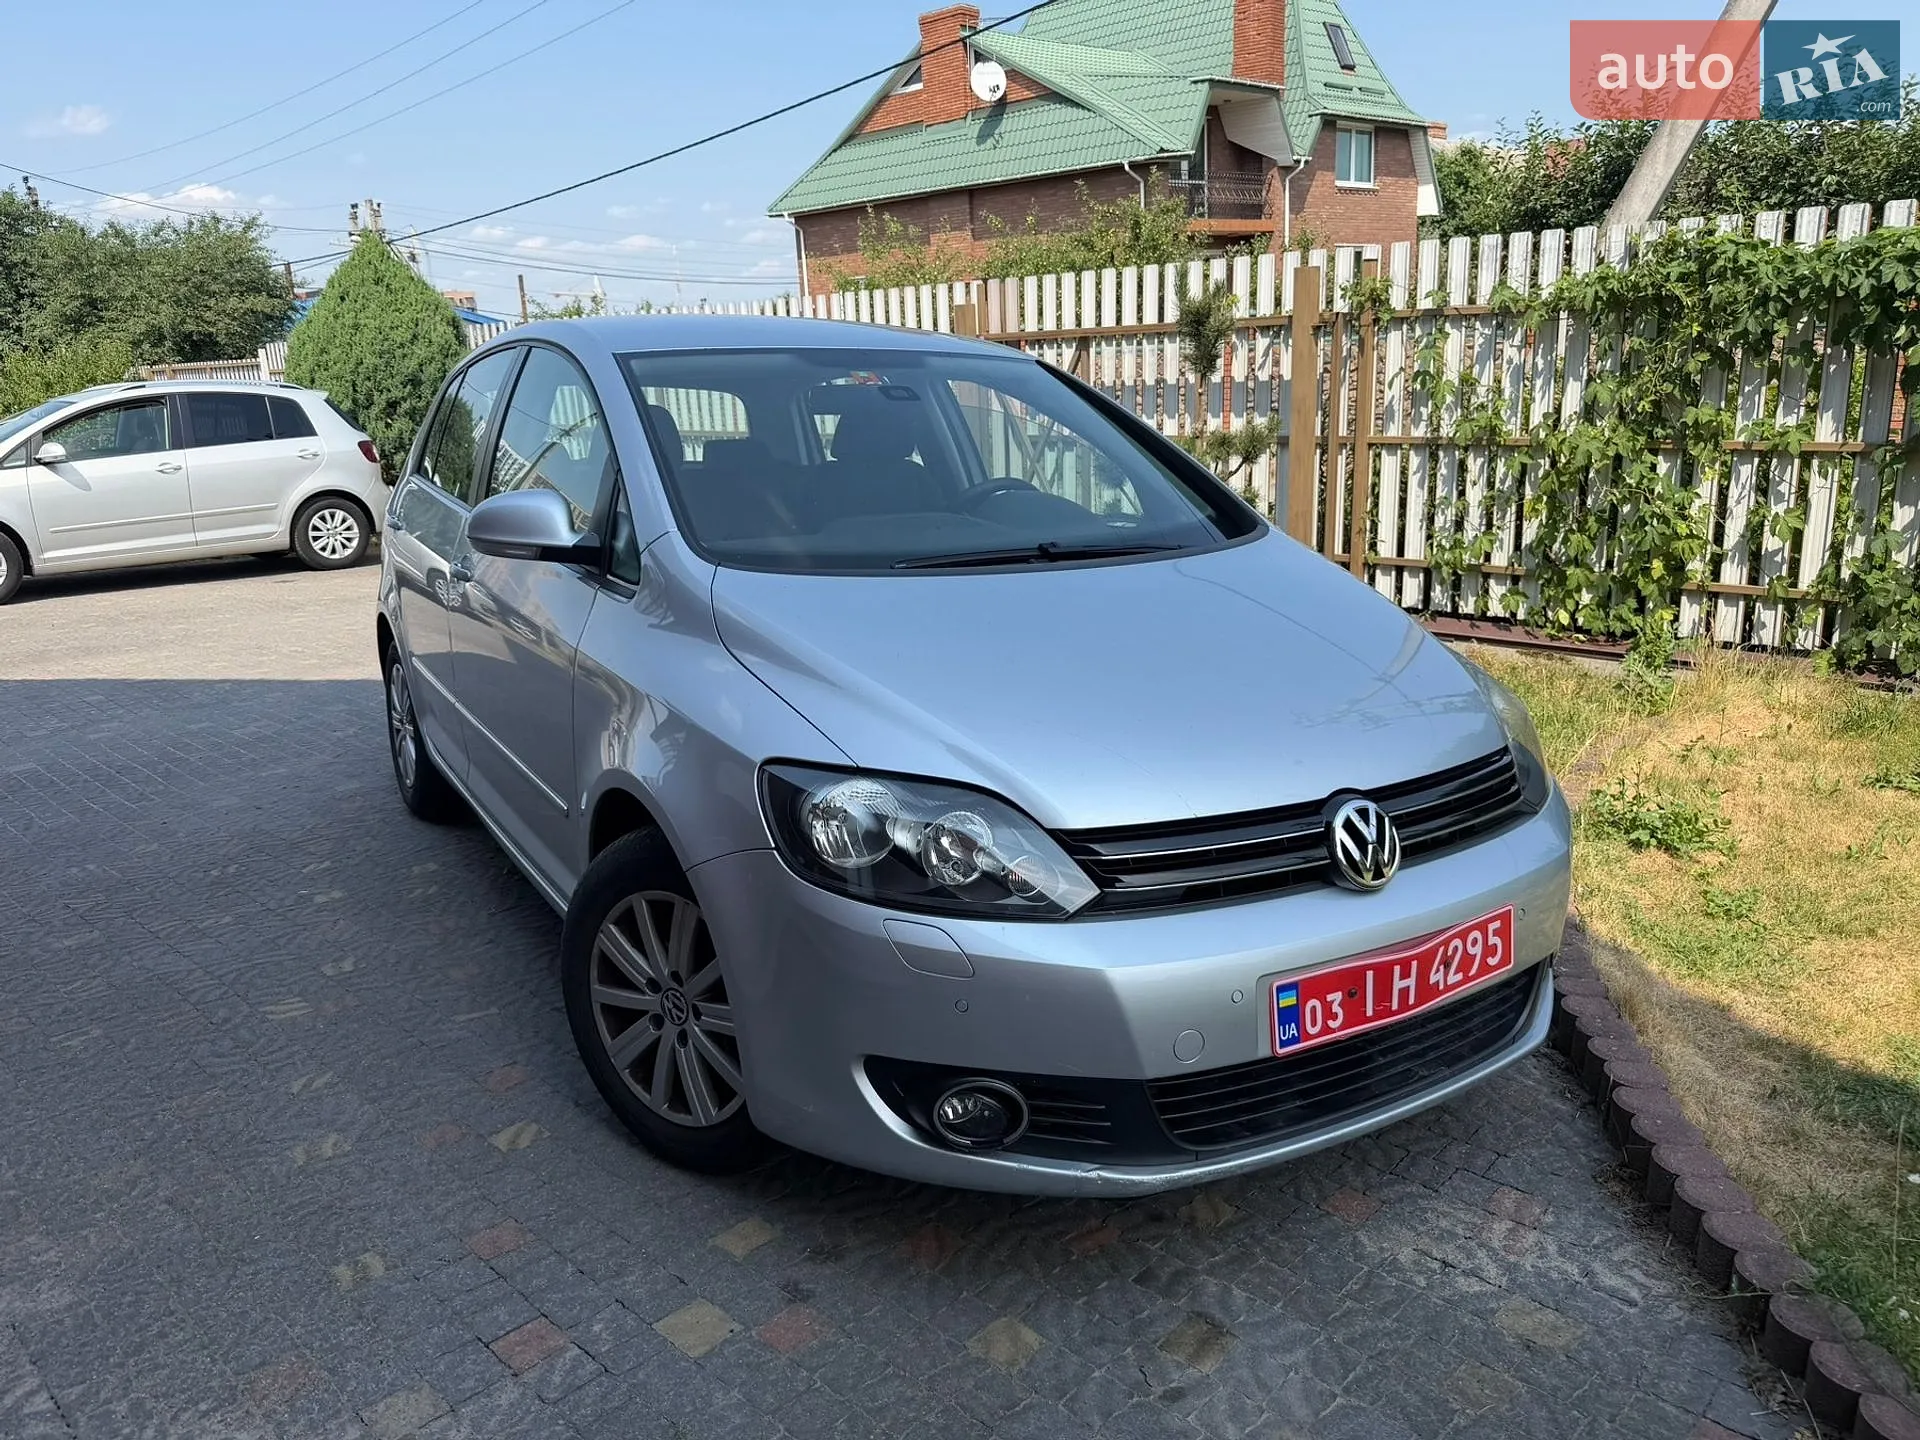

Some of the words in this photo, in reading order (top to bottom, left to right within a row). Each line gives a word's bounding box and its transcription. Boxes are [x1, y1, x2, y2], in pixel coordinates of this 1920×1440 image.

[1305, 991, 1344, 1035] 03
[1429, 919, 1502, 991] 4295
[1280, 1022, 1298, 1040] UA
